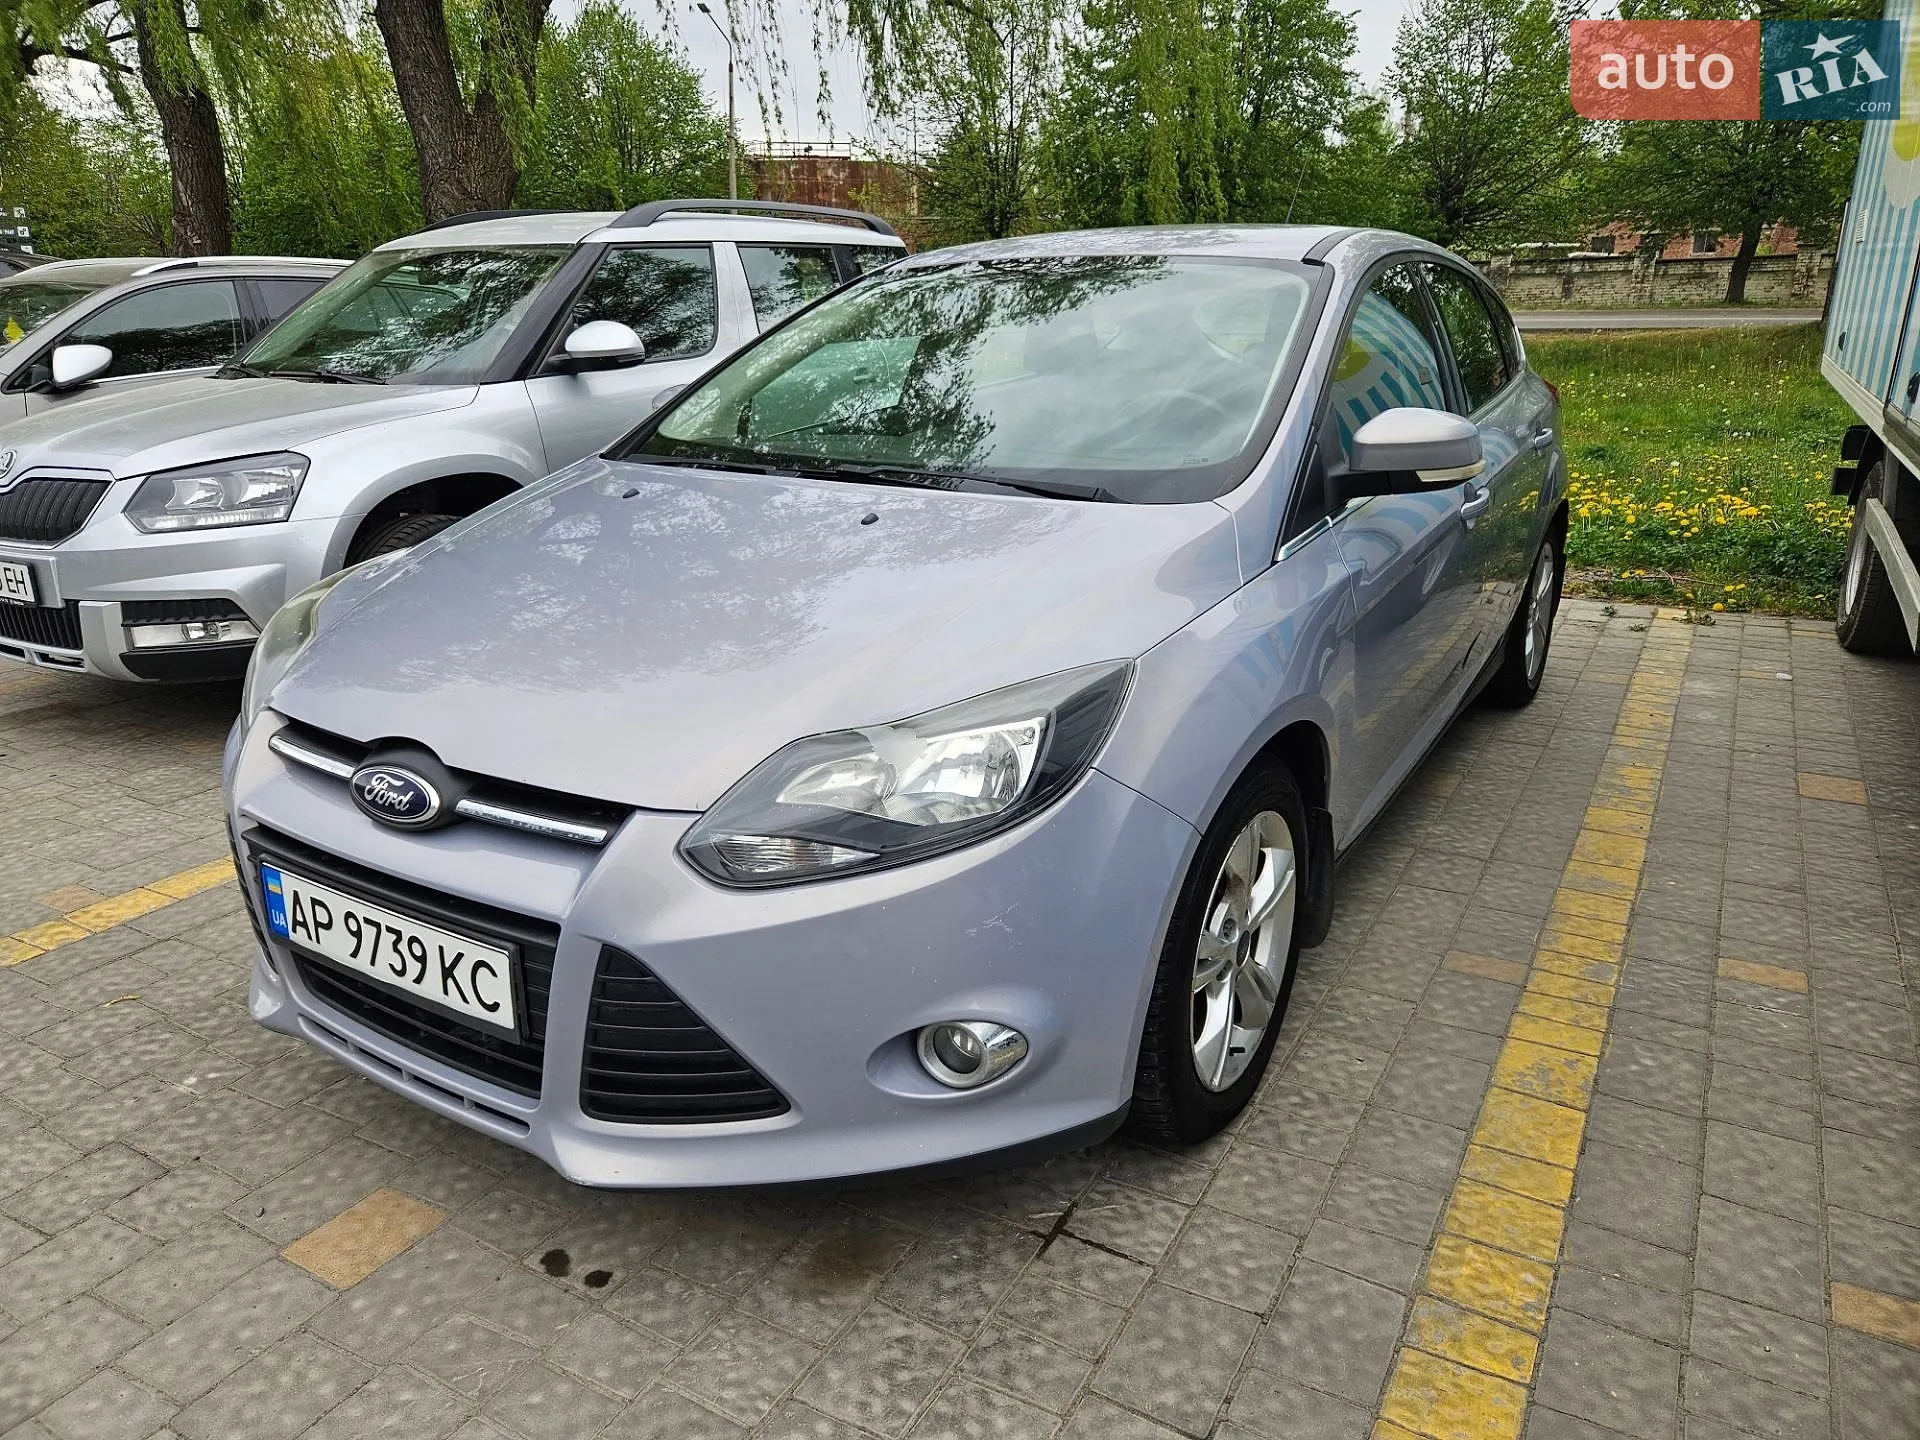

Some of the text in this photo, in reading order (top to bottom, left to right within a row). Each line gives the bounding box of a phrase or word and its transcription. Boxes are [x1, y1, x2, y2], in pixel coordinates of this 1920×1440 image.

[3, 566, 28, 596] EH
[364, 773, 415, 811] Ford
[271, 909, 288, 929] UA
[291, 889, 501, 1013] AP 9739 KC
